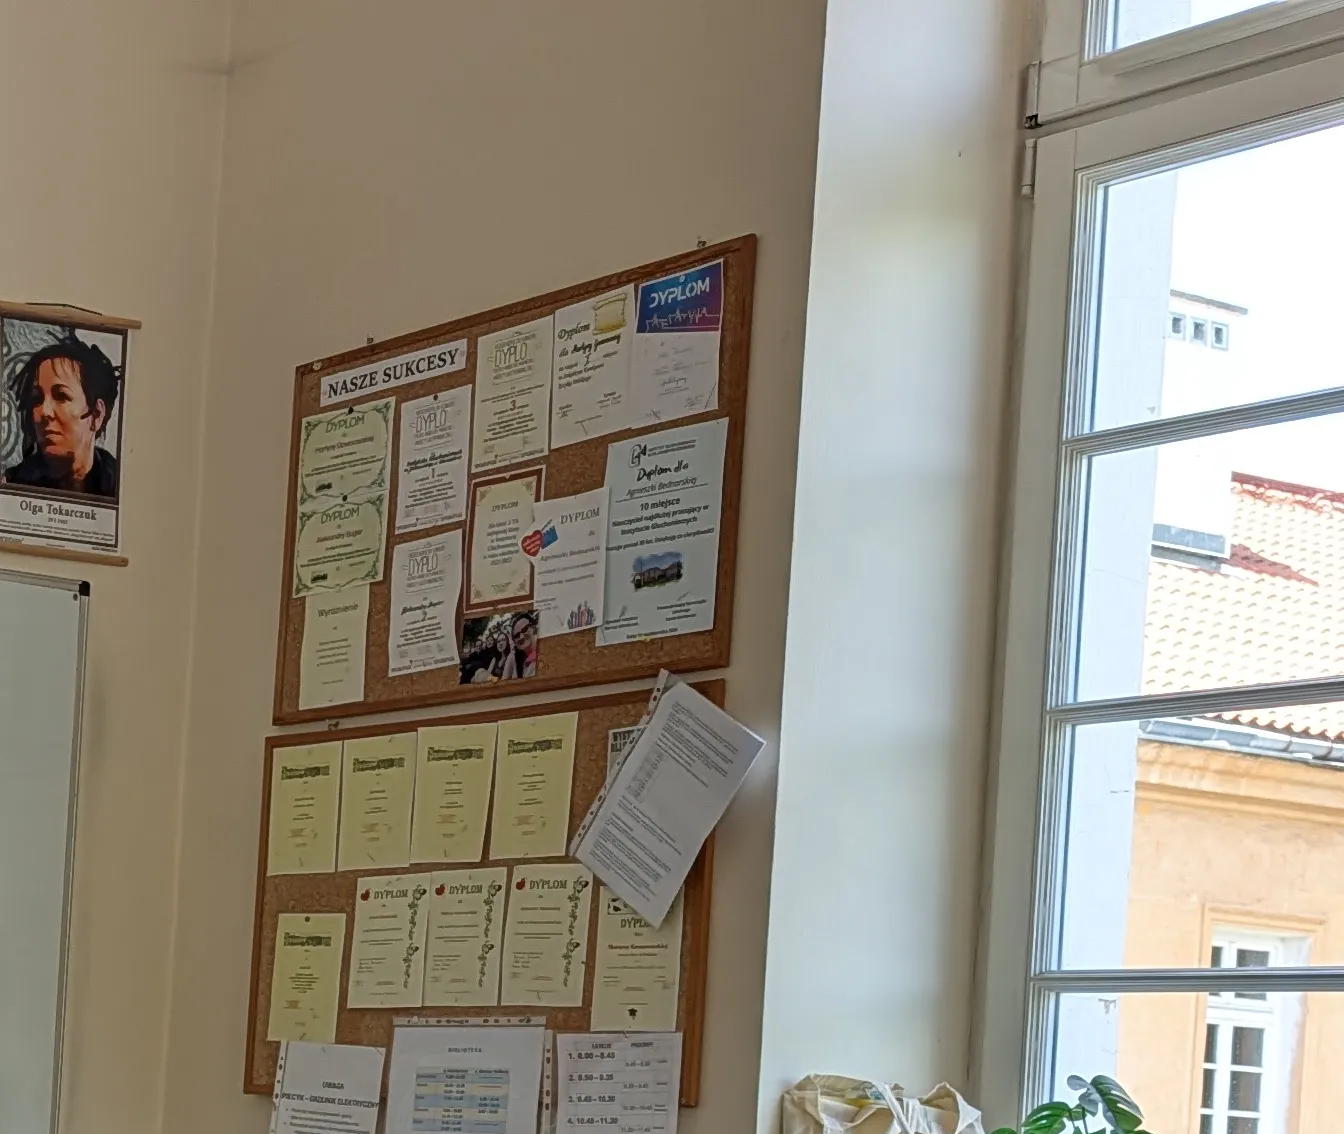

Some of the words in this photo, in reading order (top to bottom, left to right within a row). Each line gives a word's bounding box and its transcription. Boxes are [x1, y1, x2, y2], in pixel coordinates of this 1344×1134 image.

[650, 277, 710, 308] DYPLOM
[327, 371, 378, 399] NASZE
[382, 348, 459, 383] SUKCESY
[326, 414, 365, 433] DYPLOM
[637, 465, 672, 481] Dyplom
[674, 460, 688, 473] dla
[20, 500, 43, 515] Olga
[46, 504, 96, 520] Tokarczuk
[320, 507, 360, 524] DYPLOM
[561, 507, 600, 524] DYPLOM
[449, 884, 483, 895] DYPLOM
[529, 879, 567, 889] DYPLOM
[374, 889, 408, 899] DYPLOM
